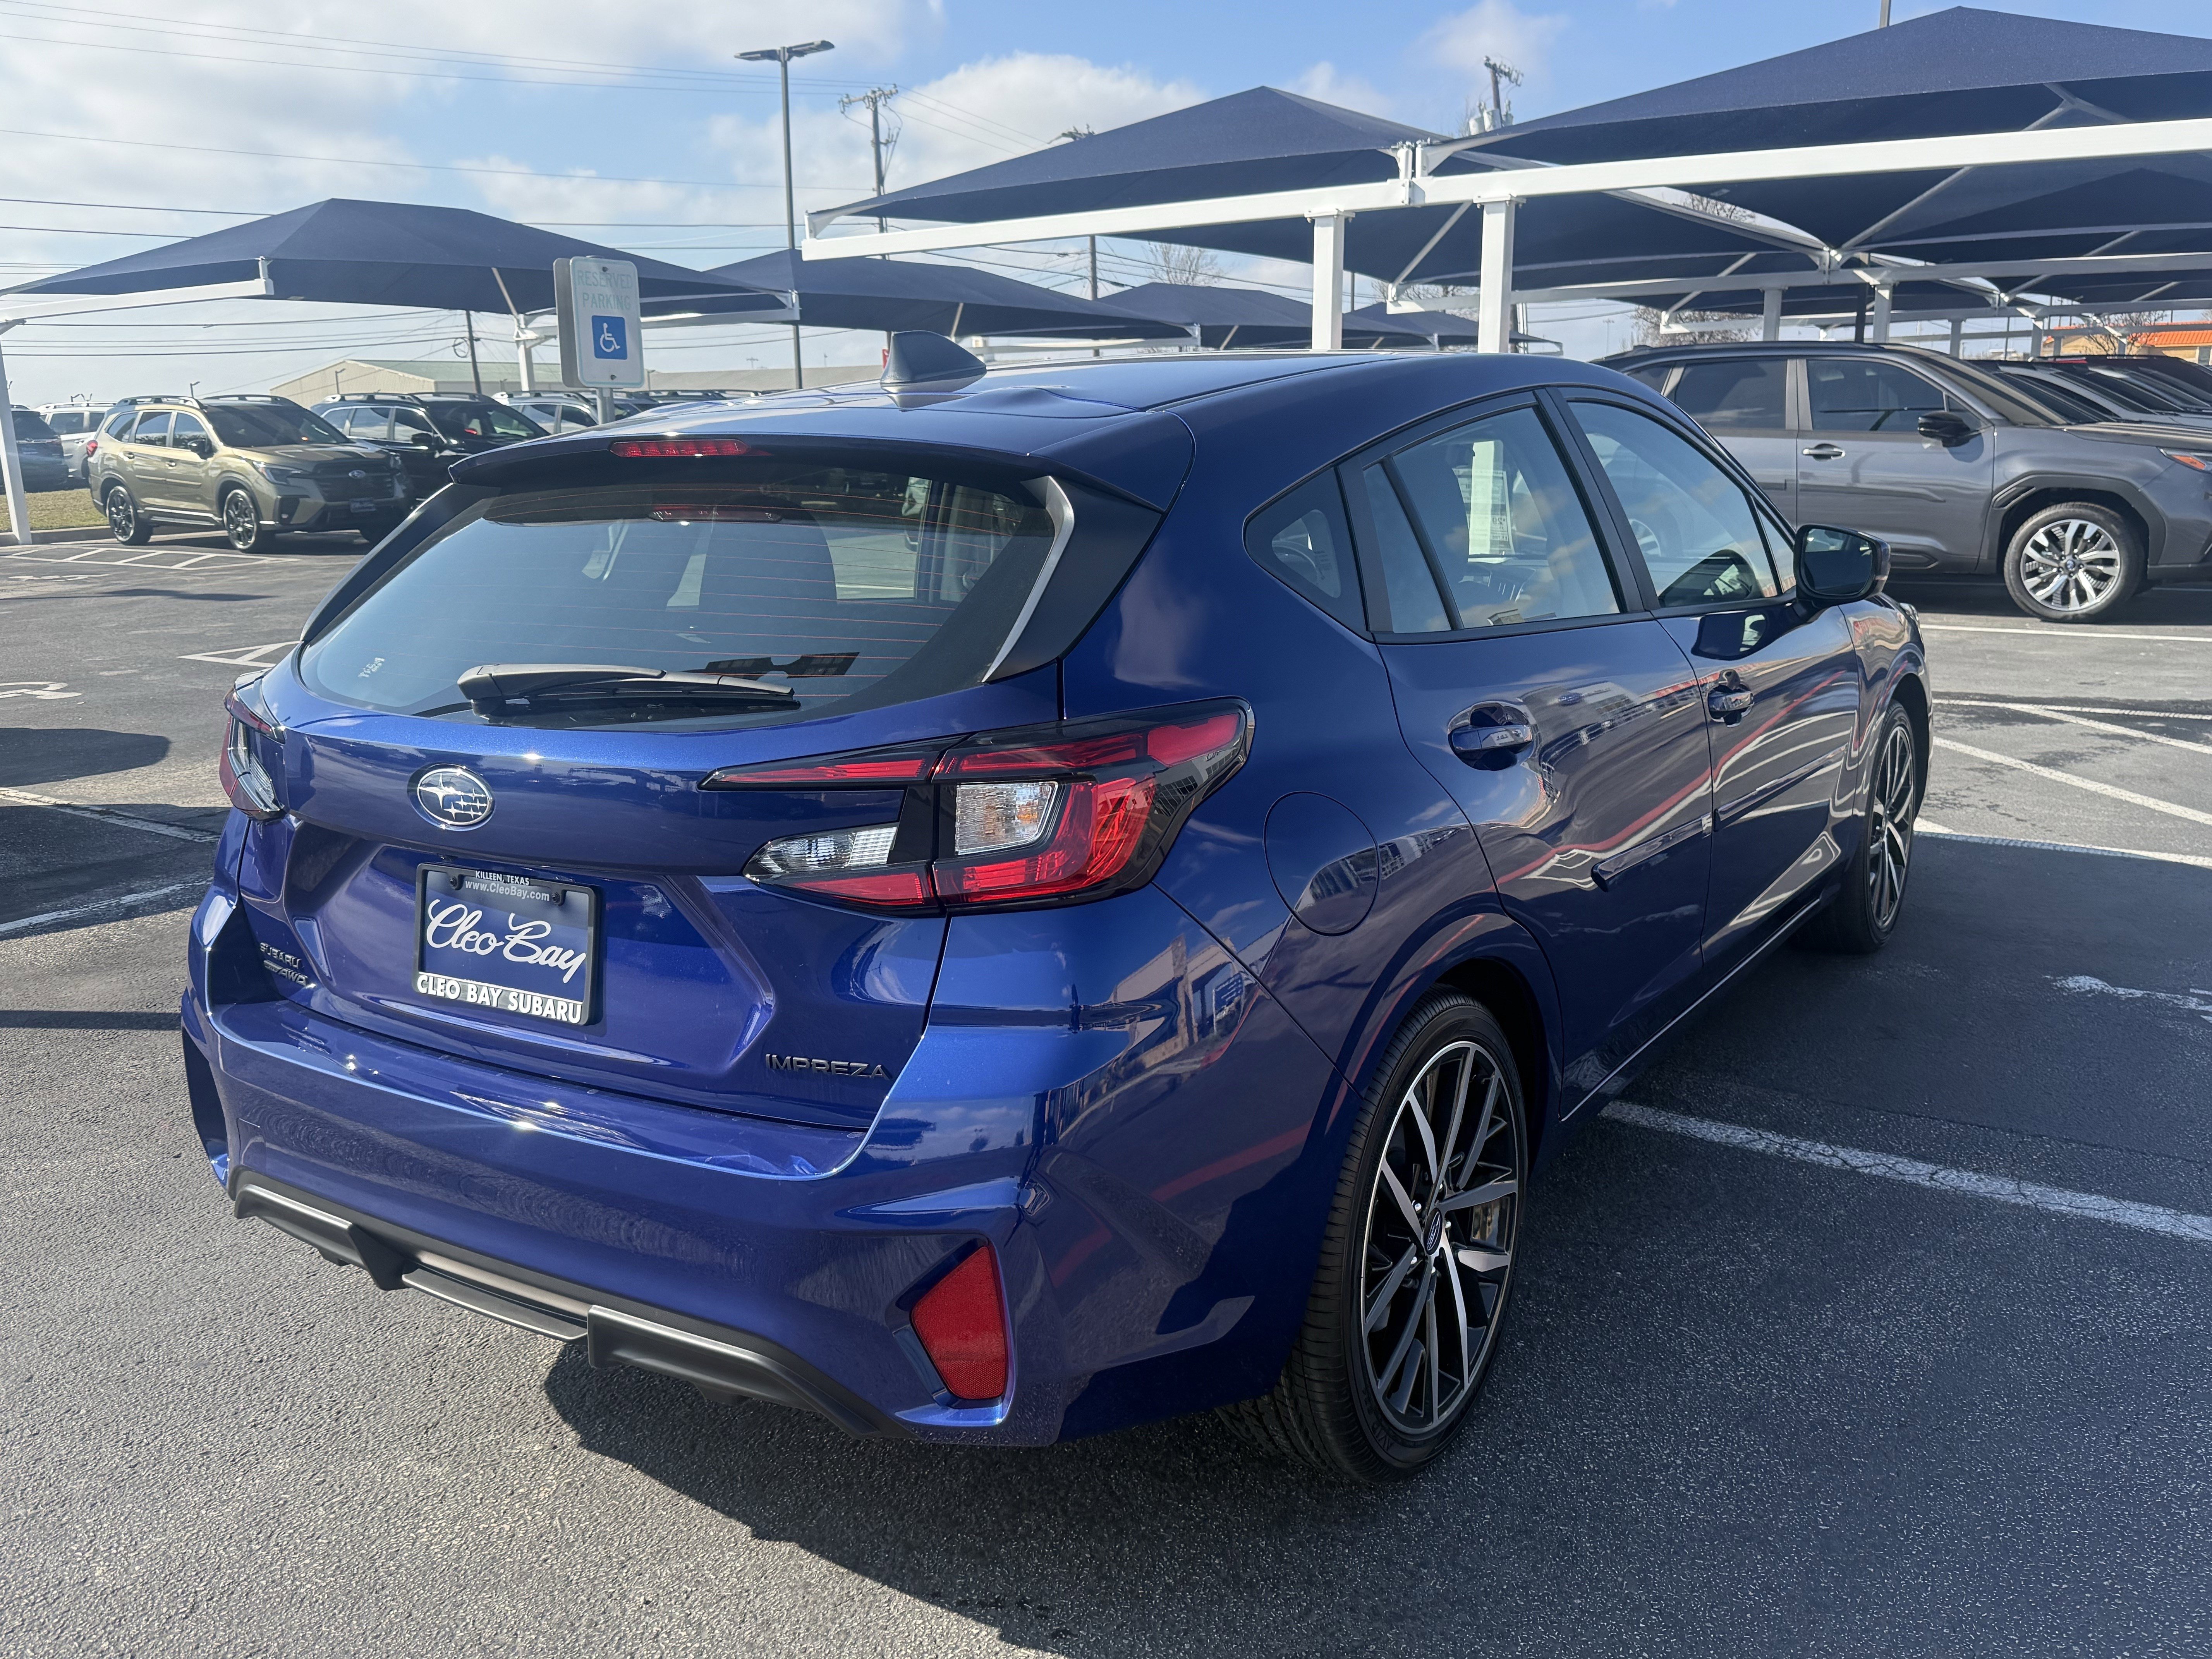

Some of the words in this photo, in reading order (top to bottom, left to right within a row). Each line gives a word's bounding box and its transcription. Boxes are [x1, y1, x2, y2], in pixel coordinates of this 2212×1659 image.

[577, 271, 633, 288] RESERVED
[582, 292, 631, 310] PARKING
[475, 870, 505, 883] KILLEEN,
[507, 875, 530, 886] TEXAS
[465, 881, 550, 902] www.CleoBay.com
[426, 899, 505, 955] Cleo
[503, 912, 587, 984] Bay
[260, 942, 302, 969] SUBARU
[417, 975, 460, 1000] CLEO
[467, 984, 503, 1008] BAY
[508, 991, 582, 1024] SUBARU
[765, 1053, 891, 1080] IMPREZA
